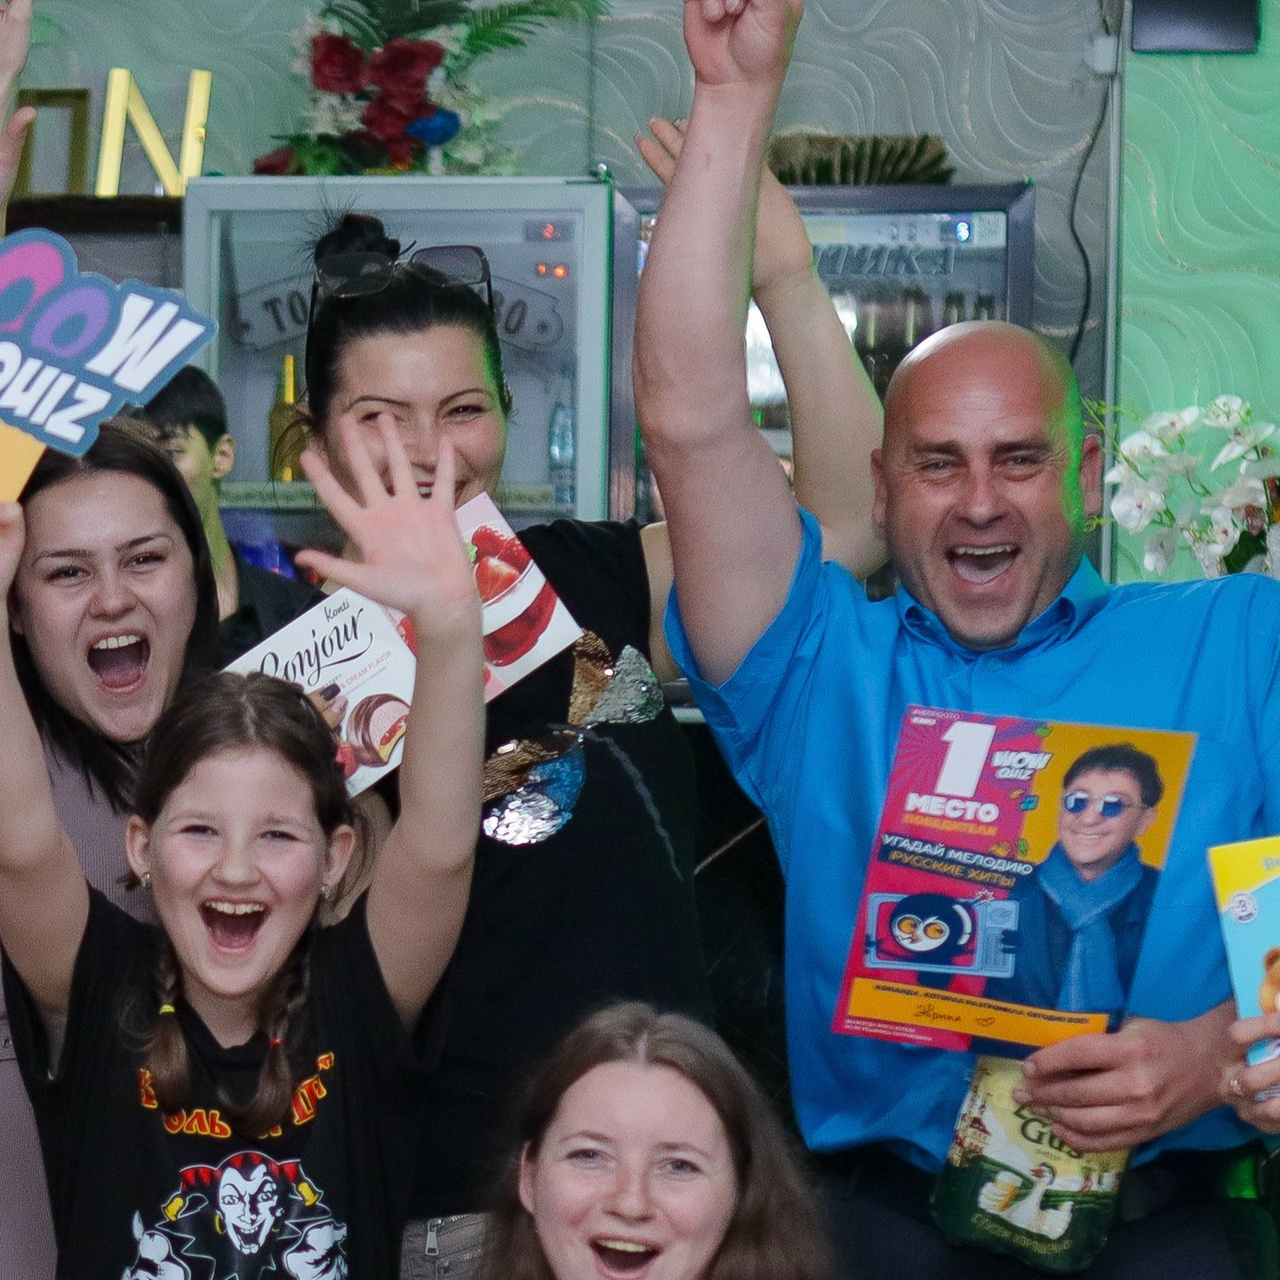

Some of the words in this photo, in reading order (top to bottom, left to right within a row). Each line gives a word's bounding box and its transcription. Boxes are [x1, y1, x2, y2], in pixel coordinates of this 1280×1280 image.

[323, 599, 351, 623] Konti
[934, 720, 997, 798] 1
[991, 750, 1053, 771] WOW
[995, 767, 1035, 781] QUIZ
[904, 792, 1000, 823] МЕСТО
[881, 833, 946, 857] УГАДАЙ
[946, 850, 1034, 876] МЕЛОДИЮ
